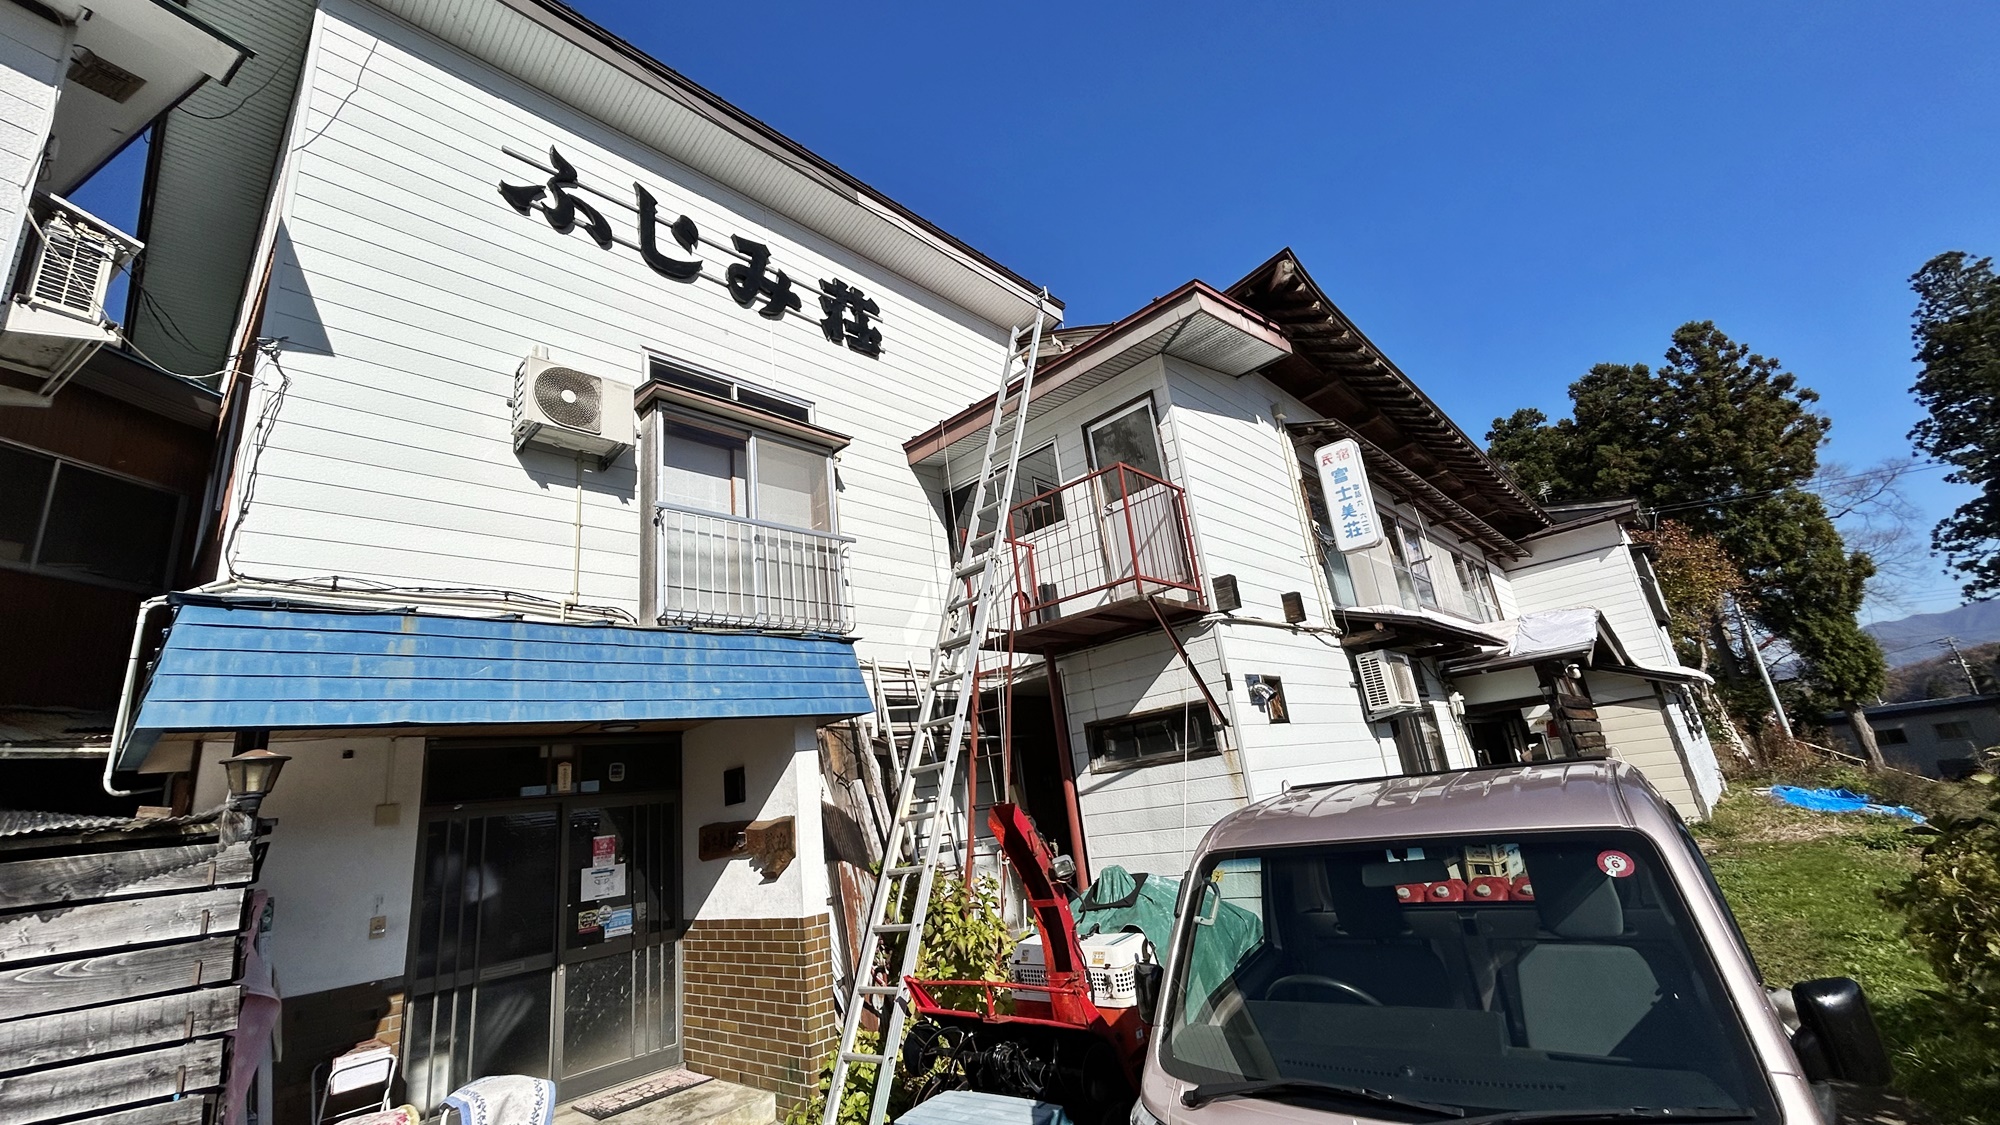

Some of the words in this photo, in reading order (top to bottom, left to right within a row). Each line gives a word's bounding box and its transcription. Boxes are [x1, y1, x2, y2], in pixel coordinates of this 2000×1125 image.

[498, 145, 883, 359] ふじみ荘
[1321, 448, 1350, 467] 民宿
[1331, 466, 1362, 539] 富士美荘
[1611, 860, 1620, 868] 6
